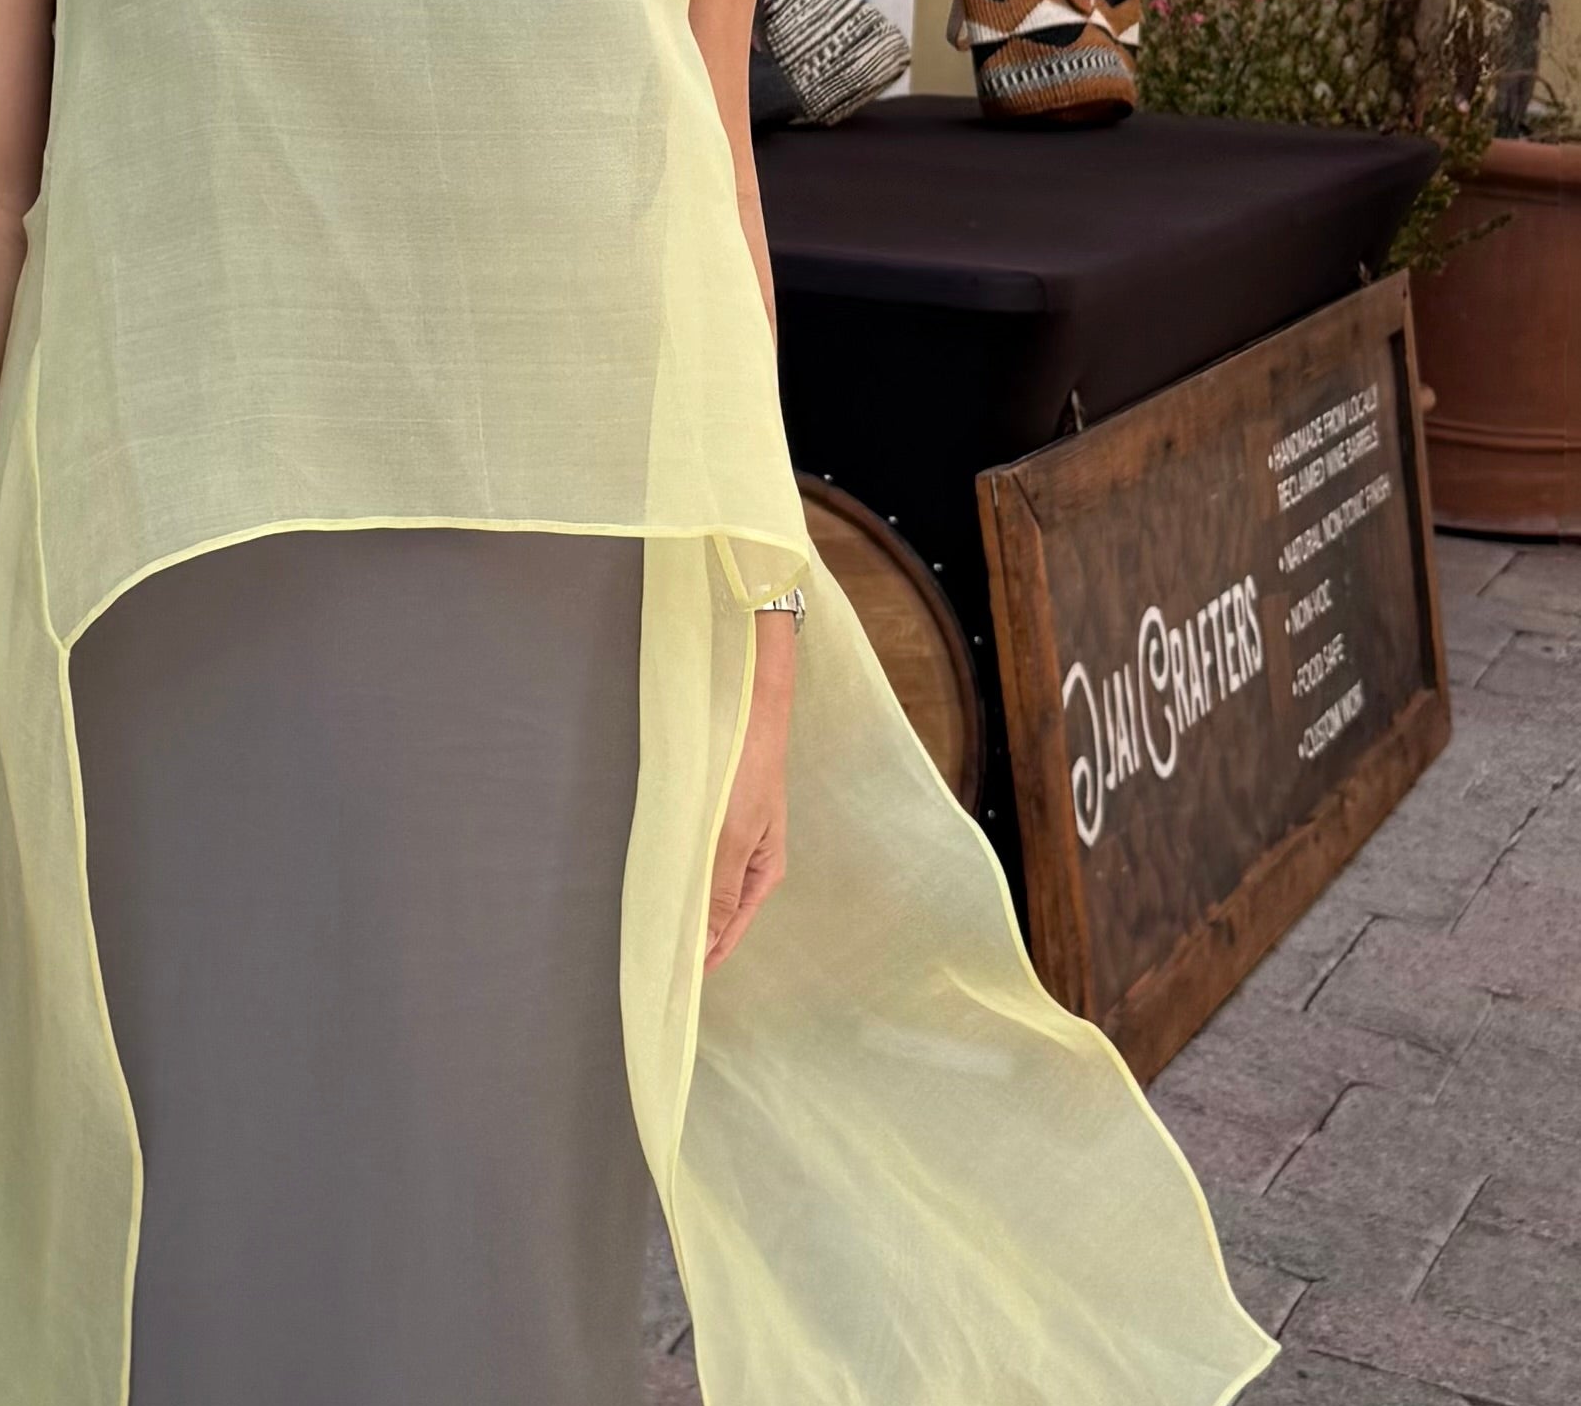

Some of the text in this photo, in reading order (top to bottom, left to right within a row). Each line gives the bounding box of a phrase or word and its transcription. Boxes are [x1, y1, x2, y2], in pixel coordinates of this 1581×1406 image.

[1273, 416, 1324, 471] HANDMADE
[1323, 403, 1347, 441] FROM
[1277, 456, 1326, 512] RECLAIMED
[1283, 522, 1323, 573] NATURAL
[1138, 574, 1263, 779] CRAFTERS
[1297, 631, 1346, 697] FOOD SAFE
[1304, 702, 1343, 759] CUSTOM
